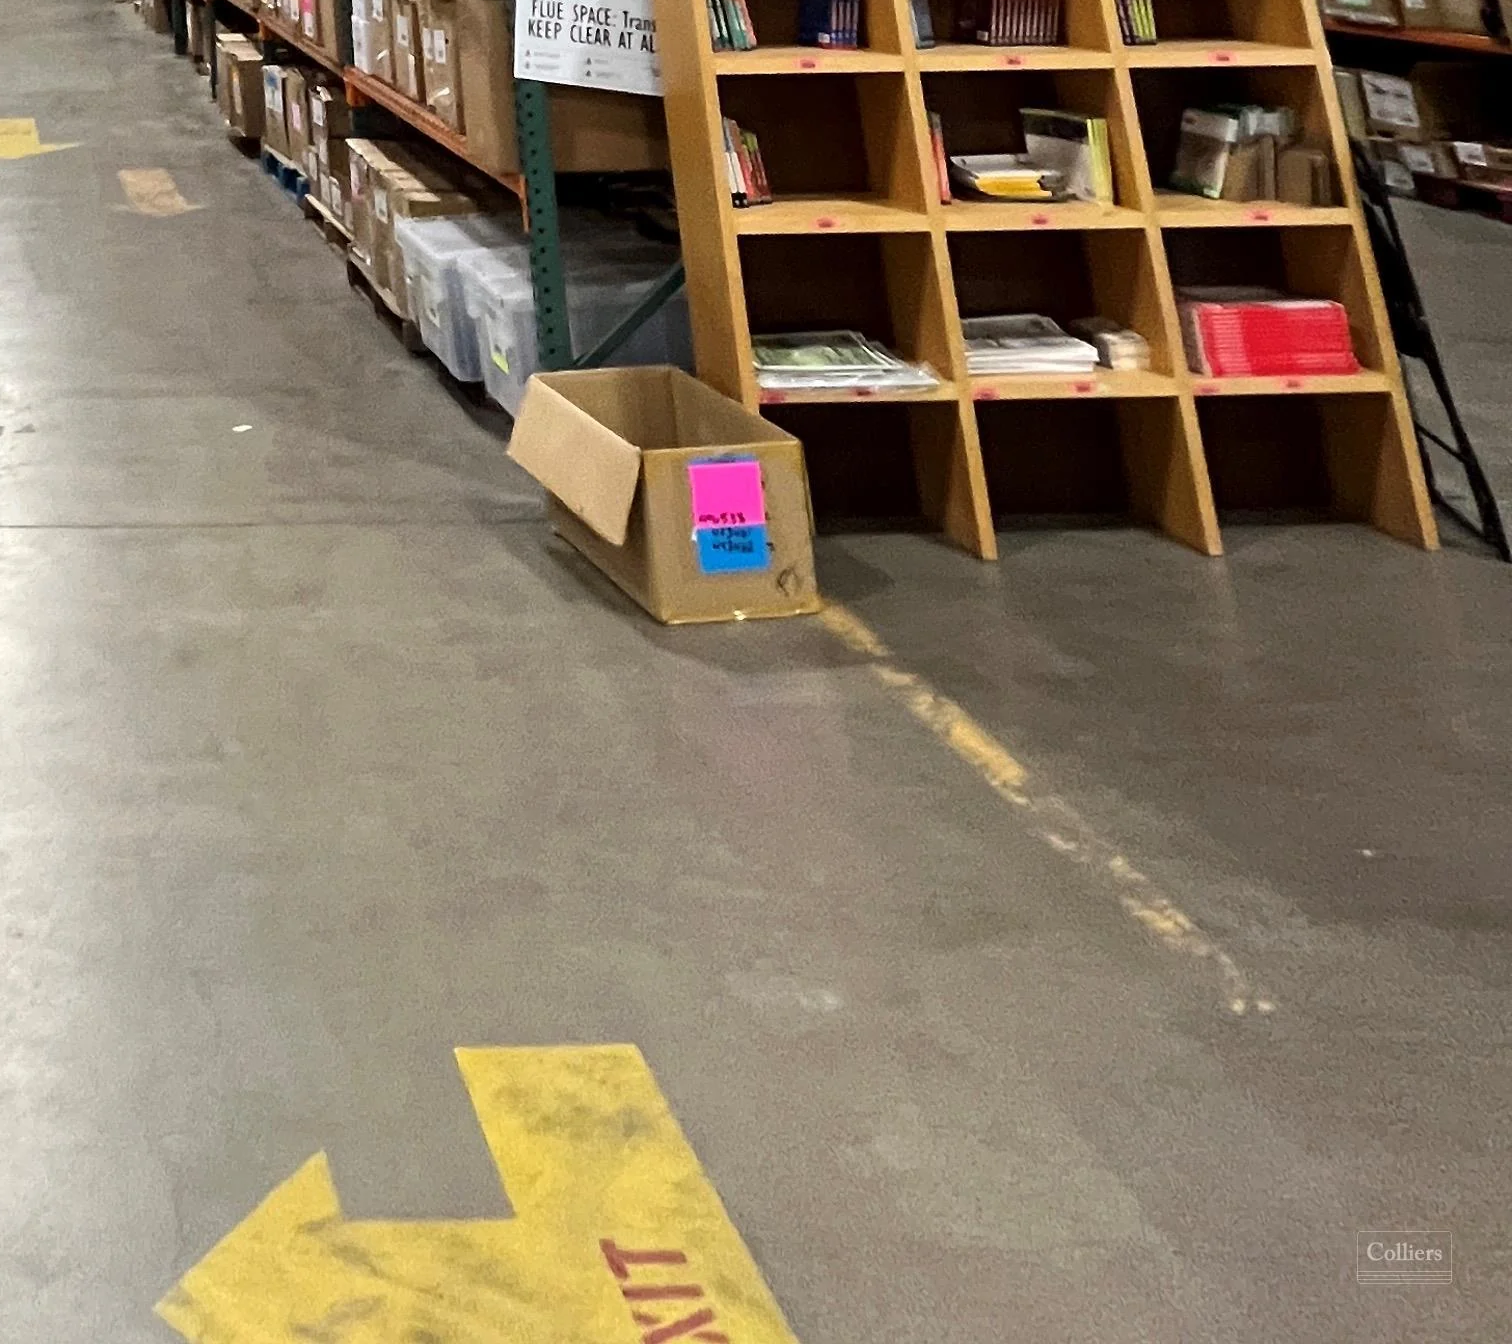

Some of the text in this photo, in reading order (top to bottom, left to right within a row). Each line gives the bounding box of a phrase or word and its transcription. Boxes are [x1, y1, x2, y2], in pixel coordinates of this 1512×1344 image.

[528, 19, 562, 40] KEEP
[570, 24, 611, 47] CLEAR
[618, 31, 634, 50] AT
